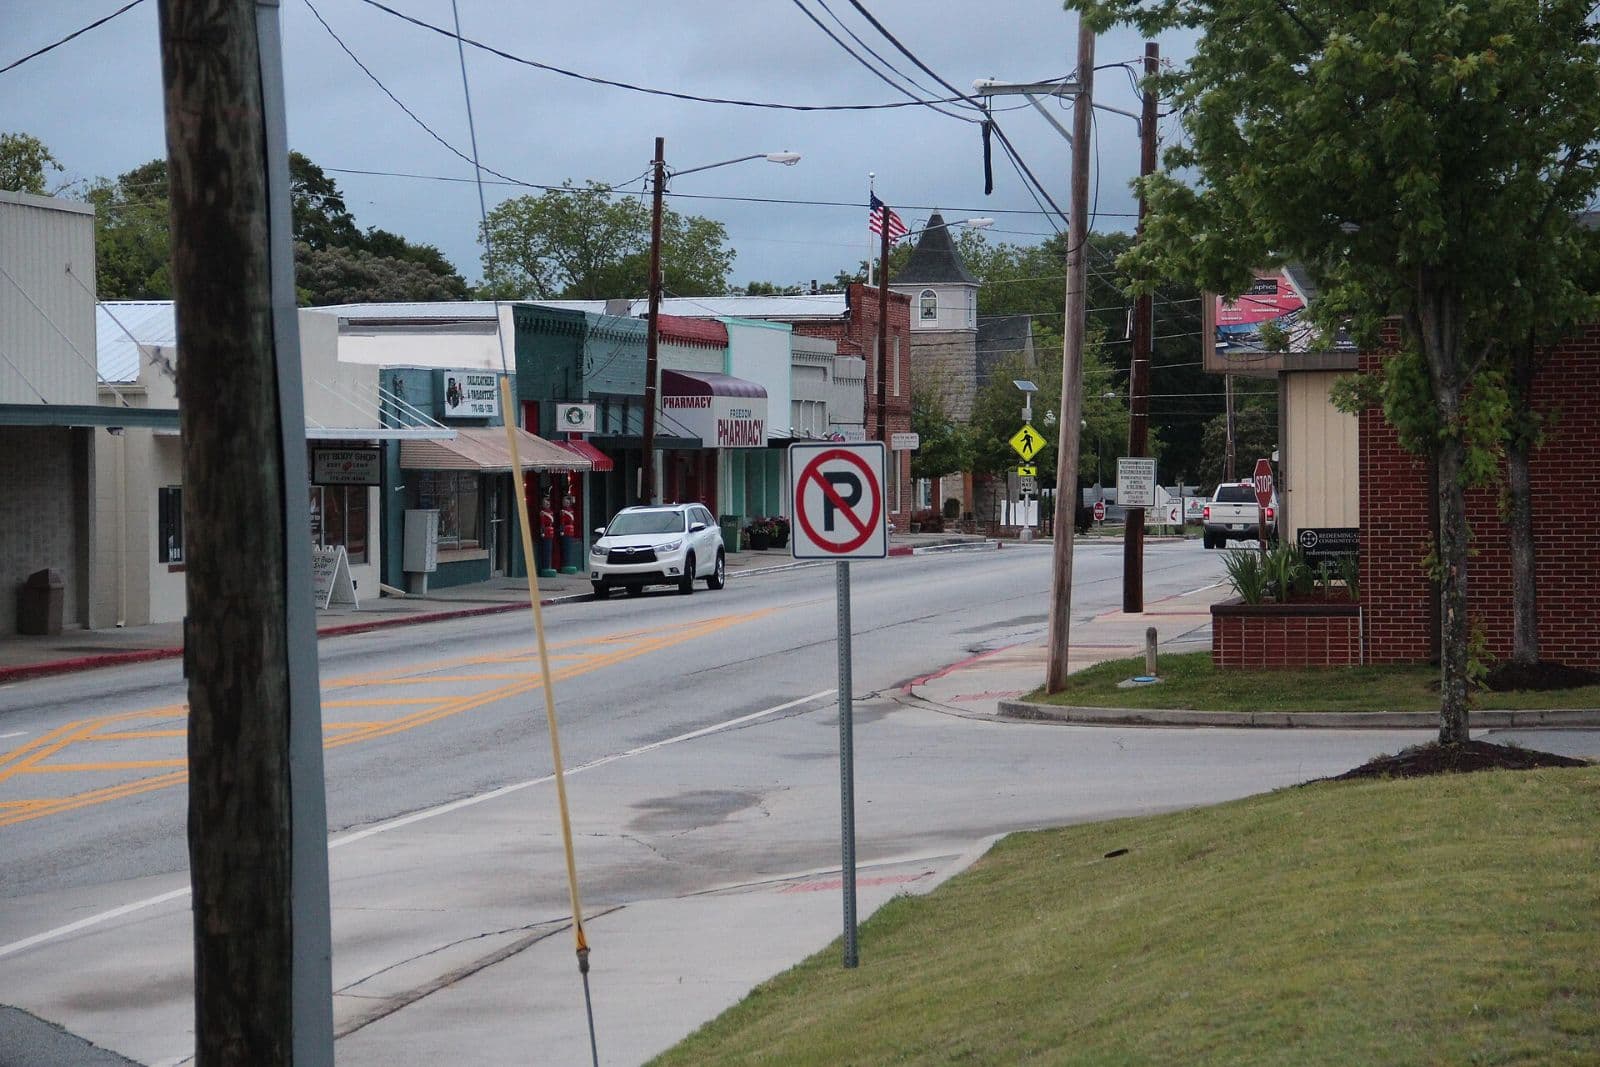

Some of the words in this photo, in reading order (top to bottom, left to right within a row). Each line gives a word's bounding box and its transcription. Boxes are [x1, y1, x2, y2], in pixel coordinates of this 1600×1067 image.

[663, 396, 712, 409] PHARMACY
[729, 408, 752, 418] FREEDOM
[717, 419, 763, 446] PHARMACY
[332, 451, 353, 460] BODY
[354, 452, 377, 462] SHOP
[1256, 475, 1271, 493] STOP
[822, 471, 863, 532] P
